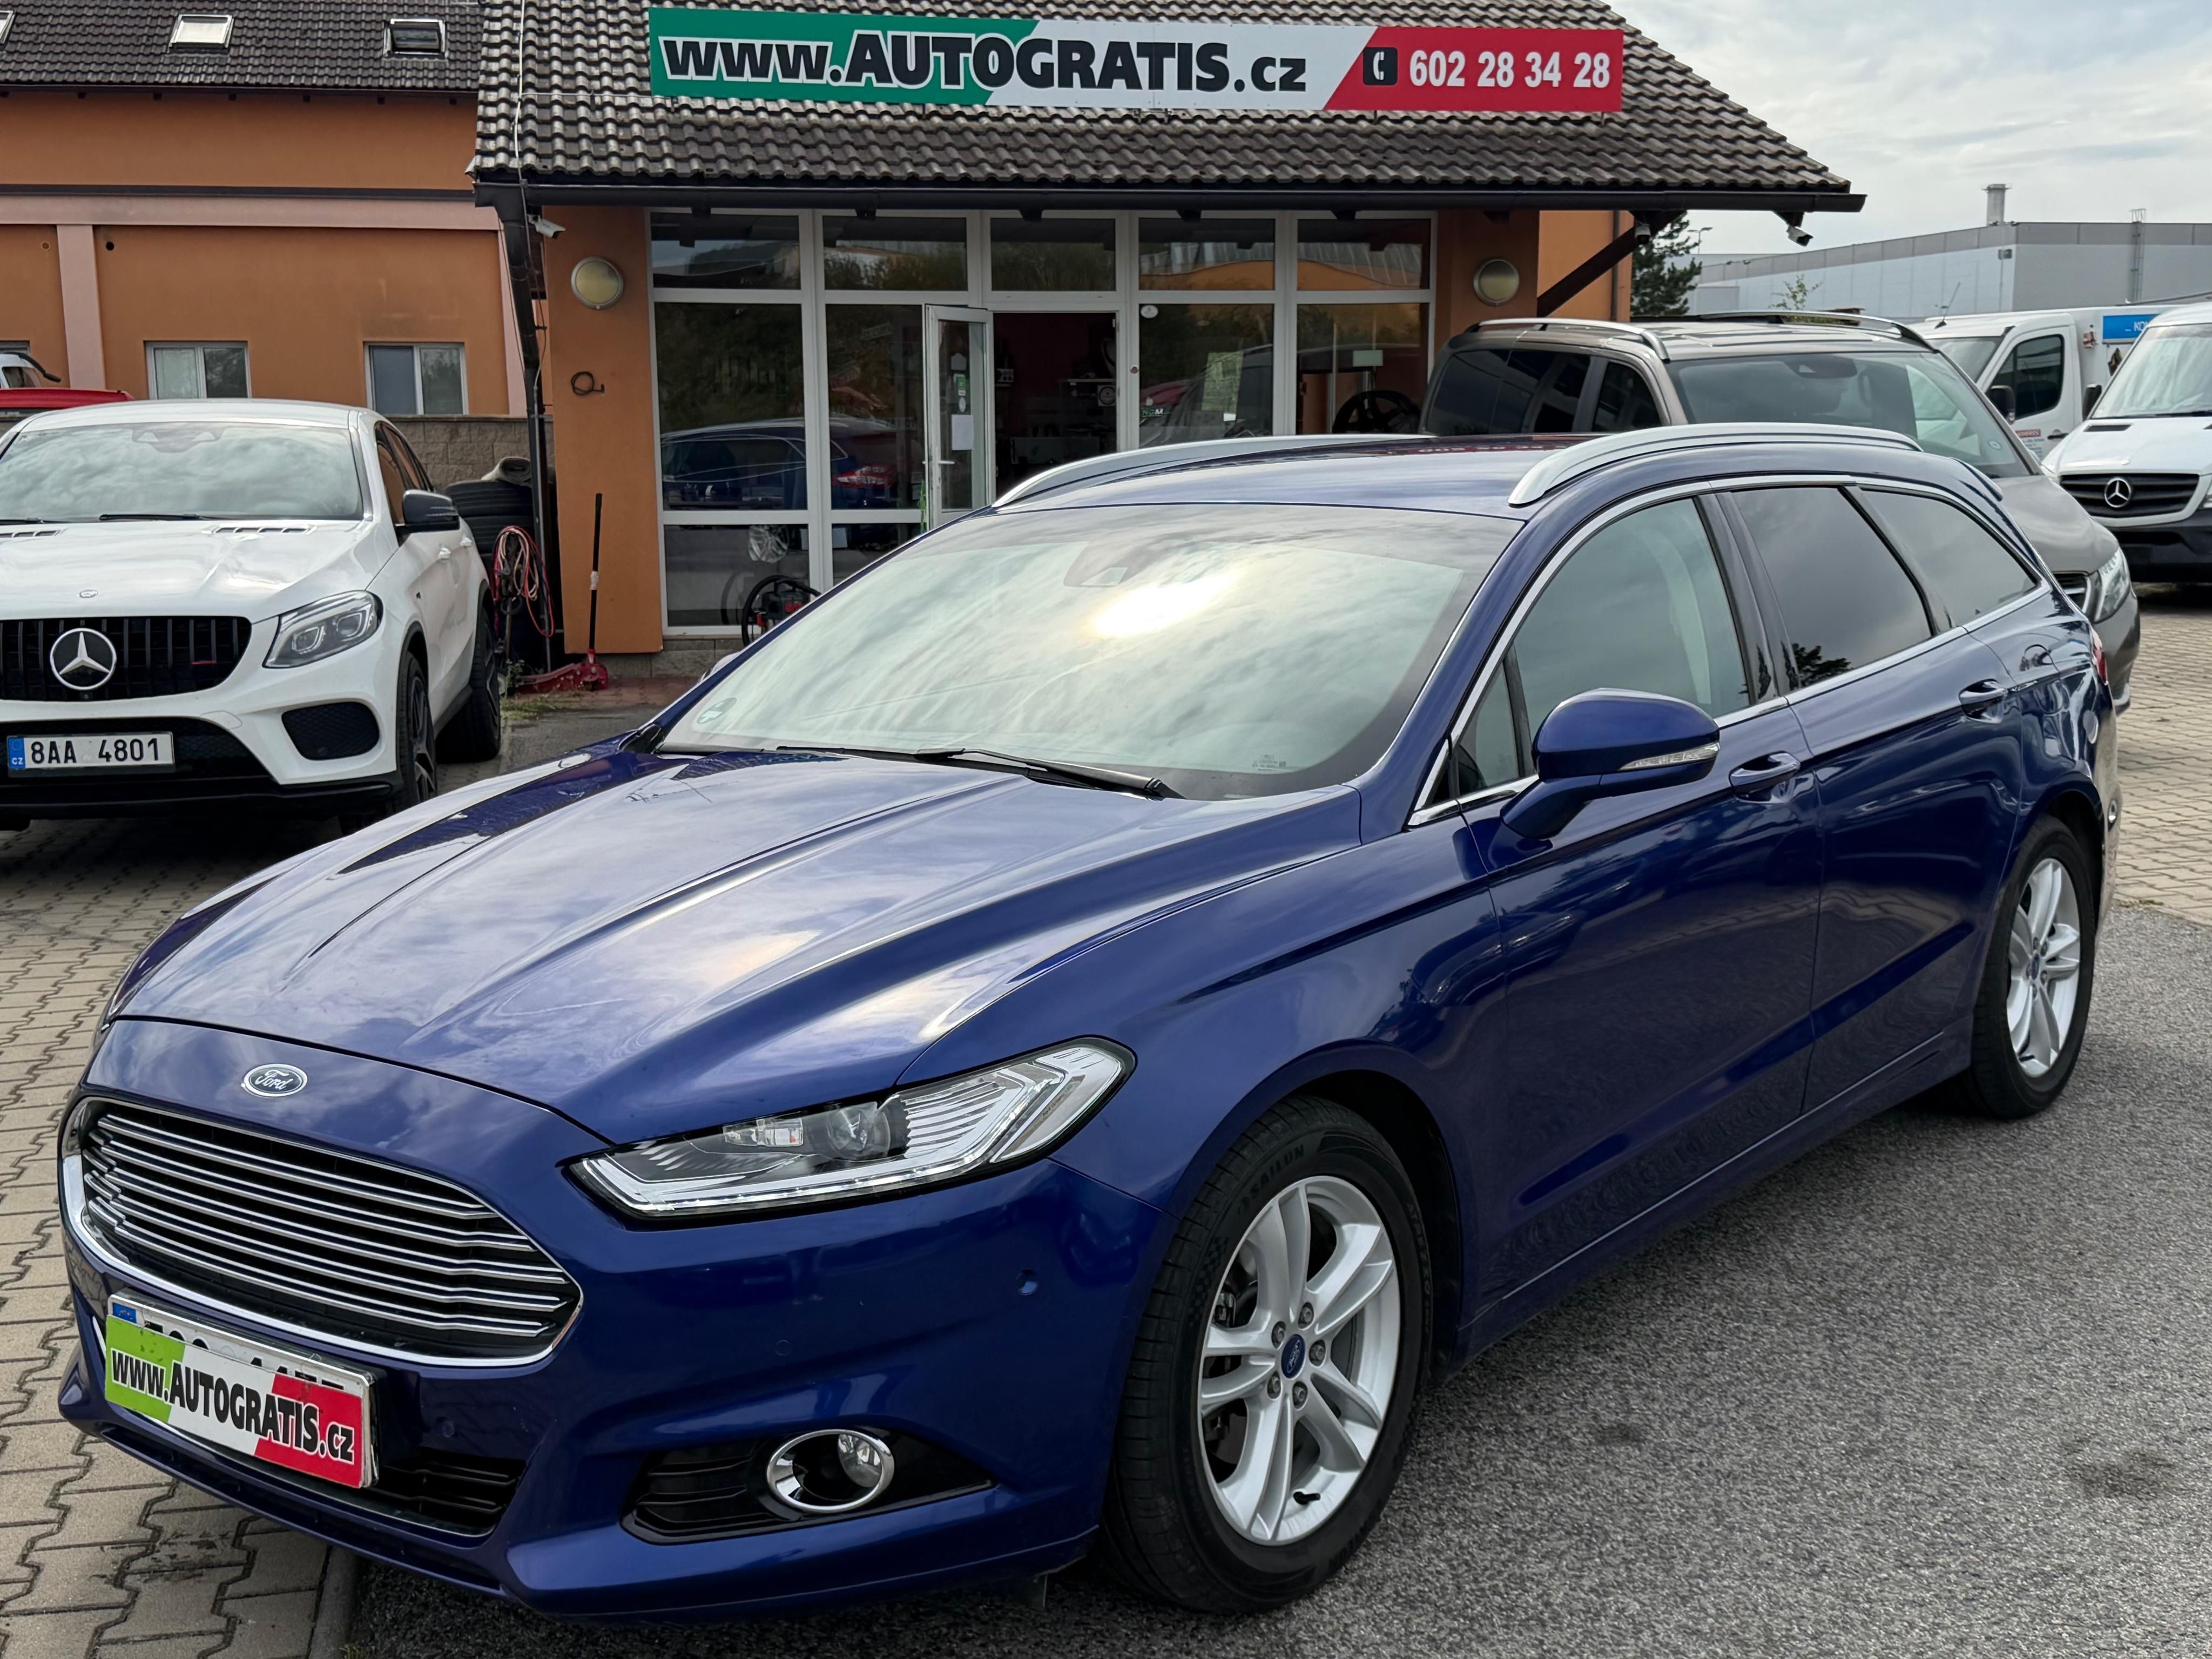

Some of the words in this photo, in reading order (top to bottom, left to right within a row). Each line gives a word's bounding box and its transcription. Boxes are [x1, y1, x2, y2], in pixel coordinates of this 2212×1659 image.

[662, 32, 1307, 93] www.AUTOGRATIS.cz
[1409, 50, 1466, 88] 602
[1476, 50, 1514, 88] 28
[1524, 51, 1561, 88] 34
[1572, 52, 1611, 89] 28
[12, 757, 24, 765] CZ
[31, 740, 77, 764] 8AA
[98, 738, 159, 763] 4801
[254, 1069, 294, 1090] Ford
[111, 1350, 354, 1462] www.AUTOGRATIS.cz
